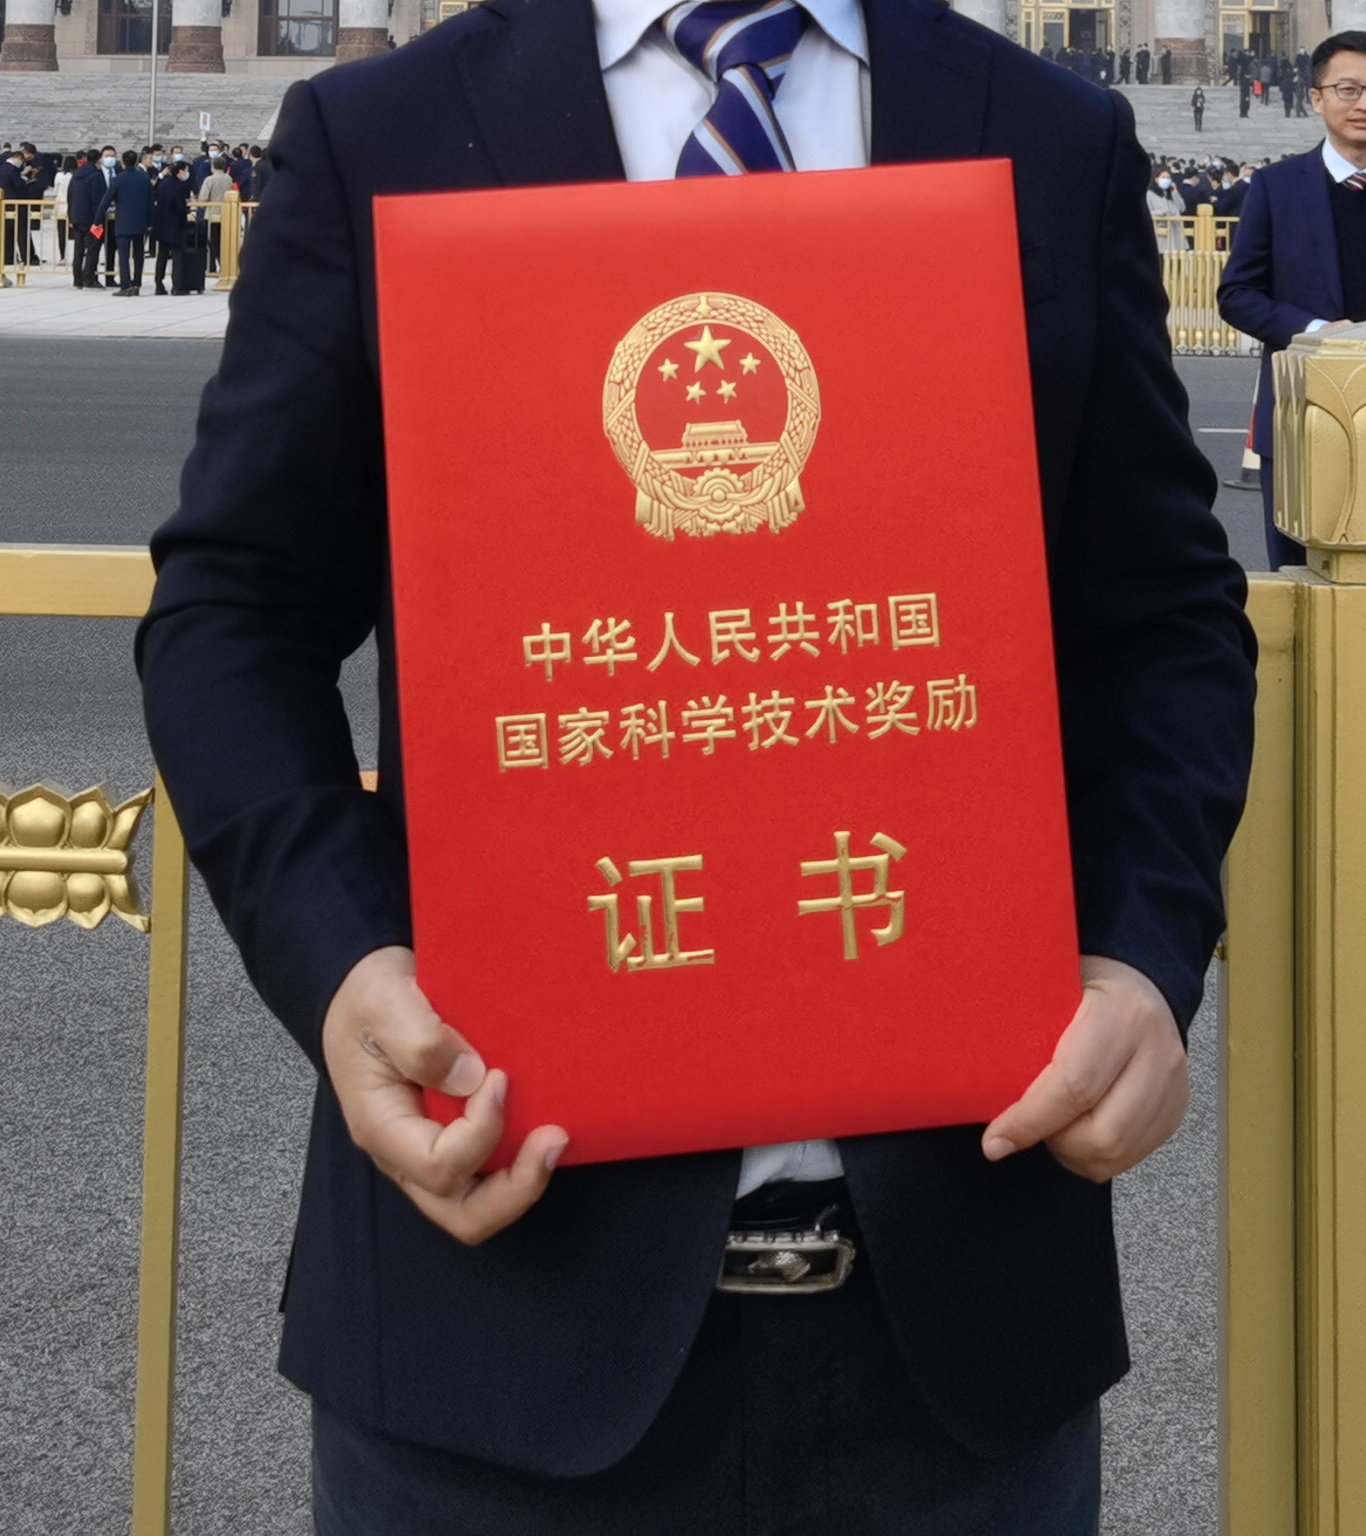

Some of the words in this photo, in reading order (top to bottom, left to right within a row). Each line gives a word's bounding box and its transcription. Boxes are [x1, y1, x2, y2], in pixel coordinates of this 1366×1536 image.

[521, 593, 940, 682] 中华人民共和国
[494, 673, 978, 770] 国家科学技术奖励
